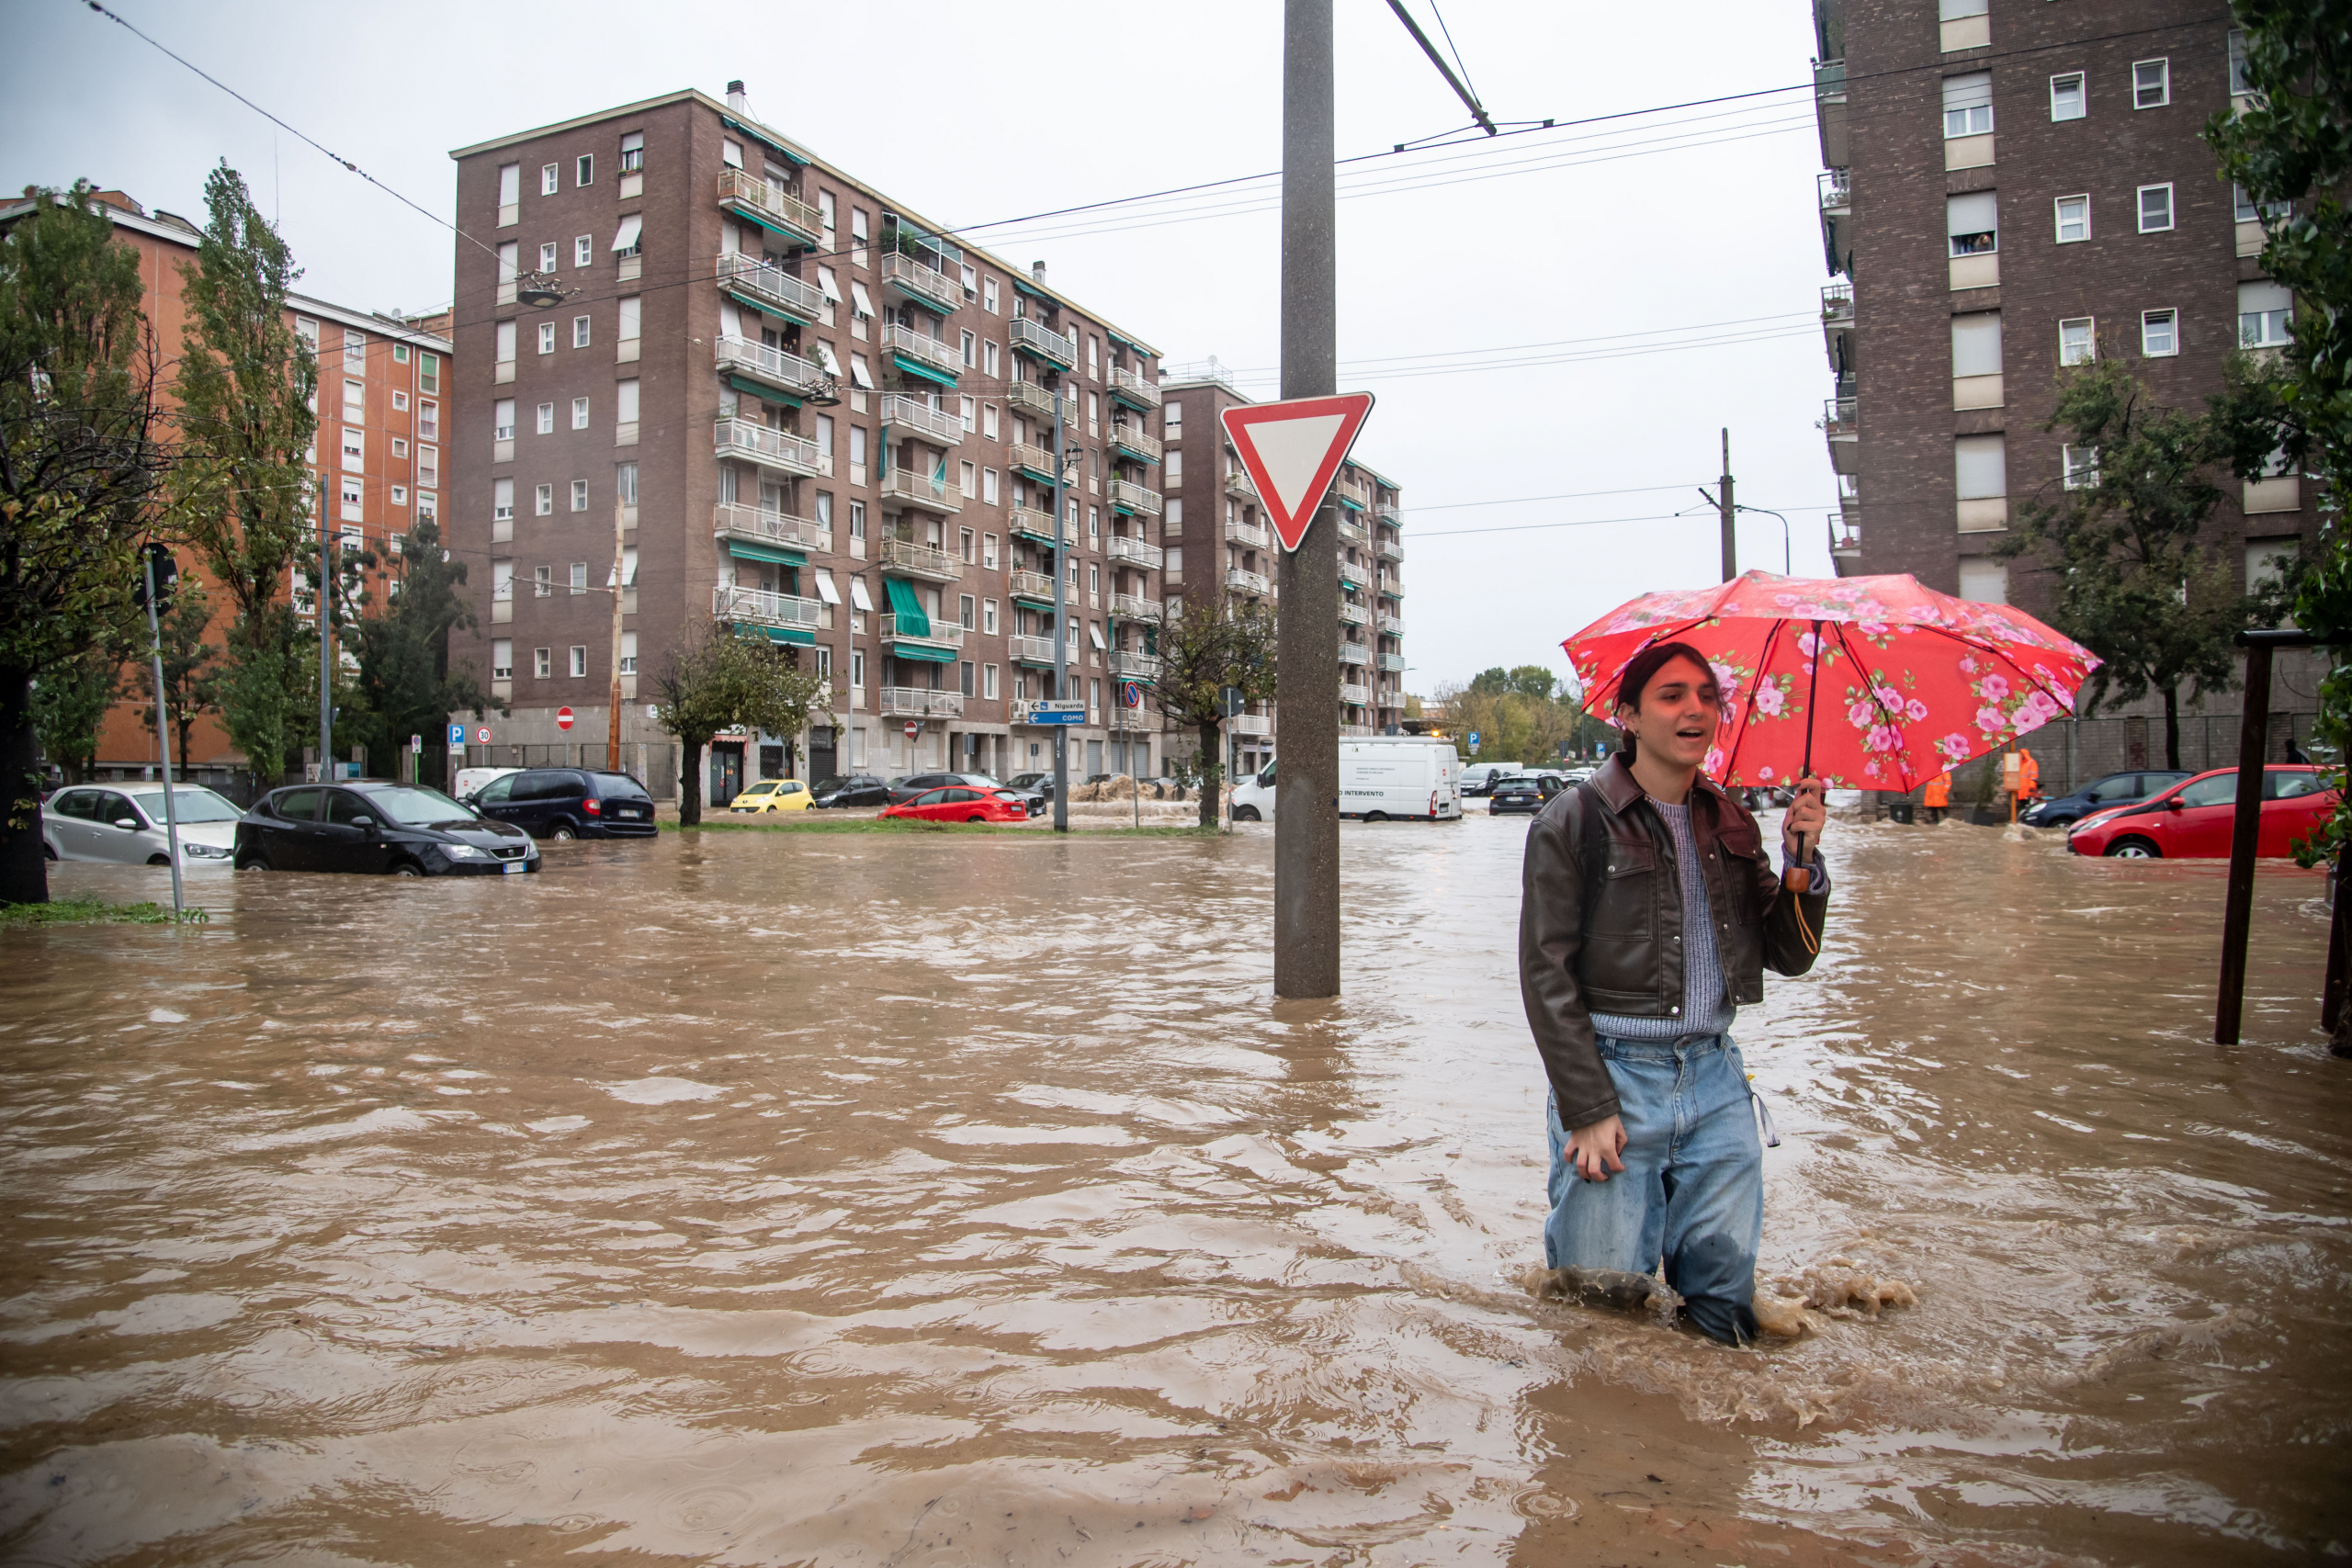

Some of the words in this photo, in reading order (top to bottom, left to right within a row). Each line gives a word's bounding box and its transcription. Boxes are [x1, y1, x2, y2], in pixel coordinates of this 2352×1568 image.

[452, 727, 461, 741] P
[481, 731, 488, 739] 30
[1470, 733, 1477, 743] P
